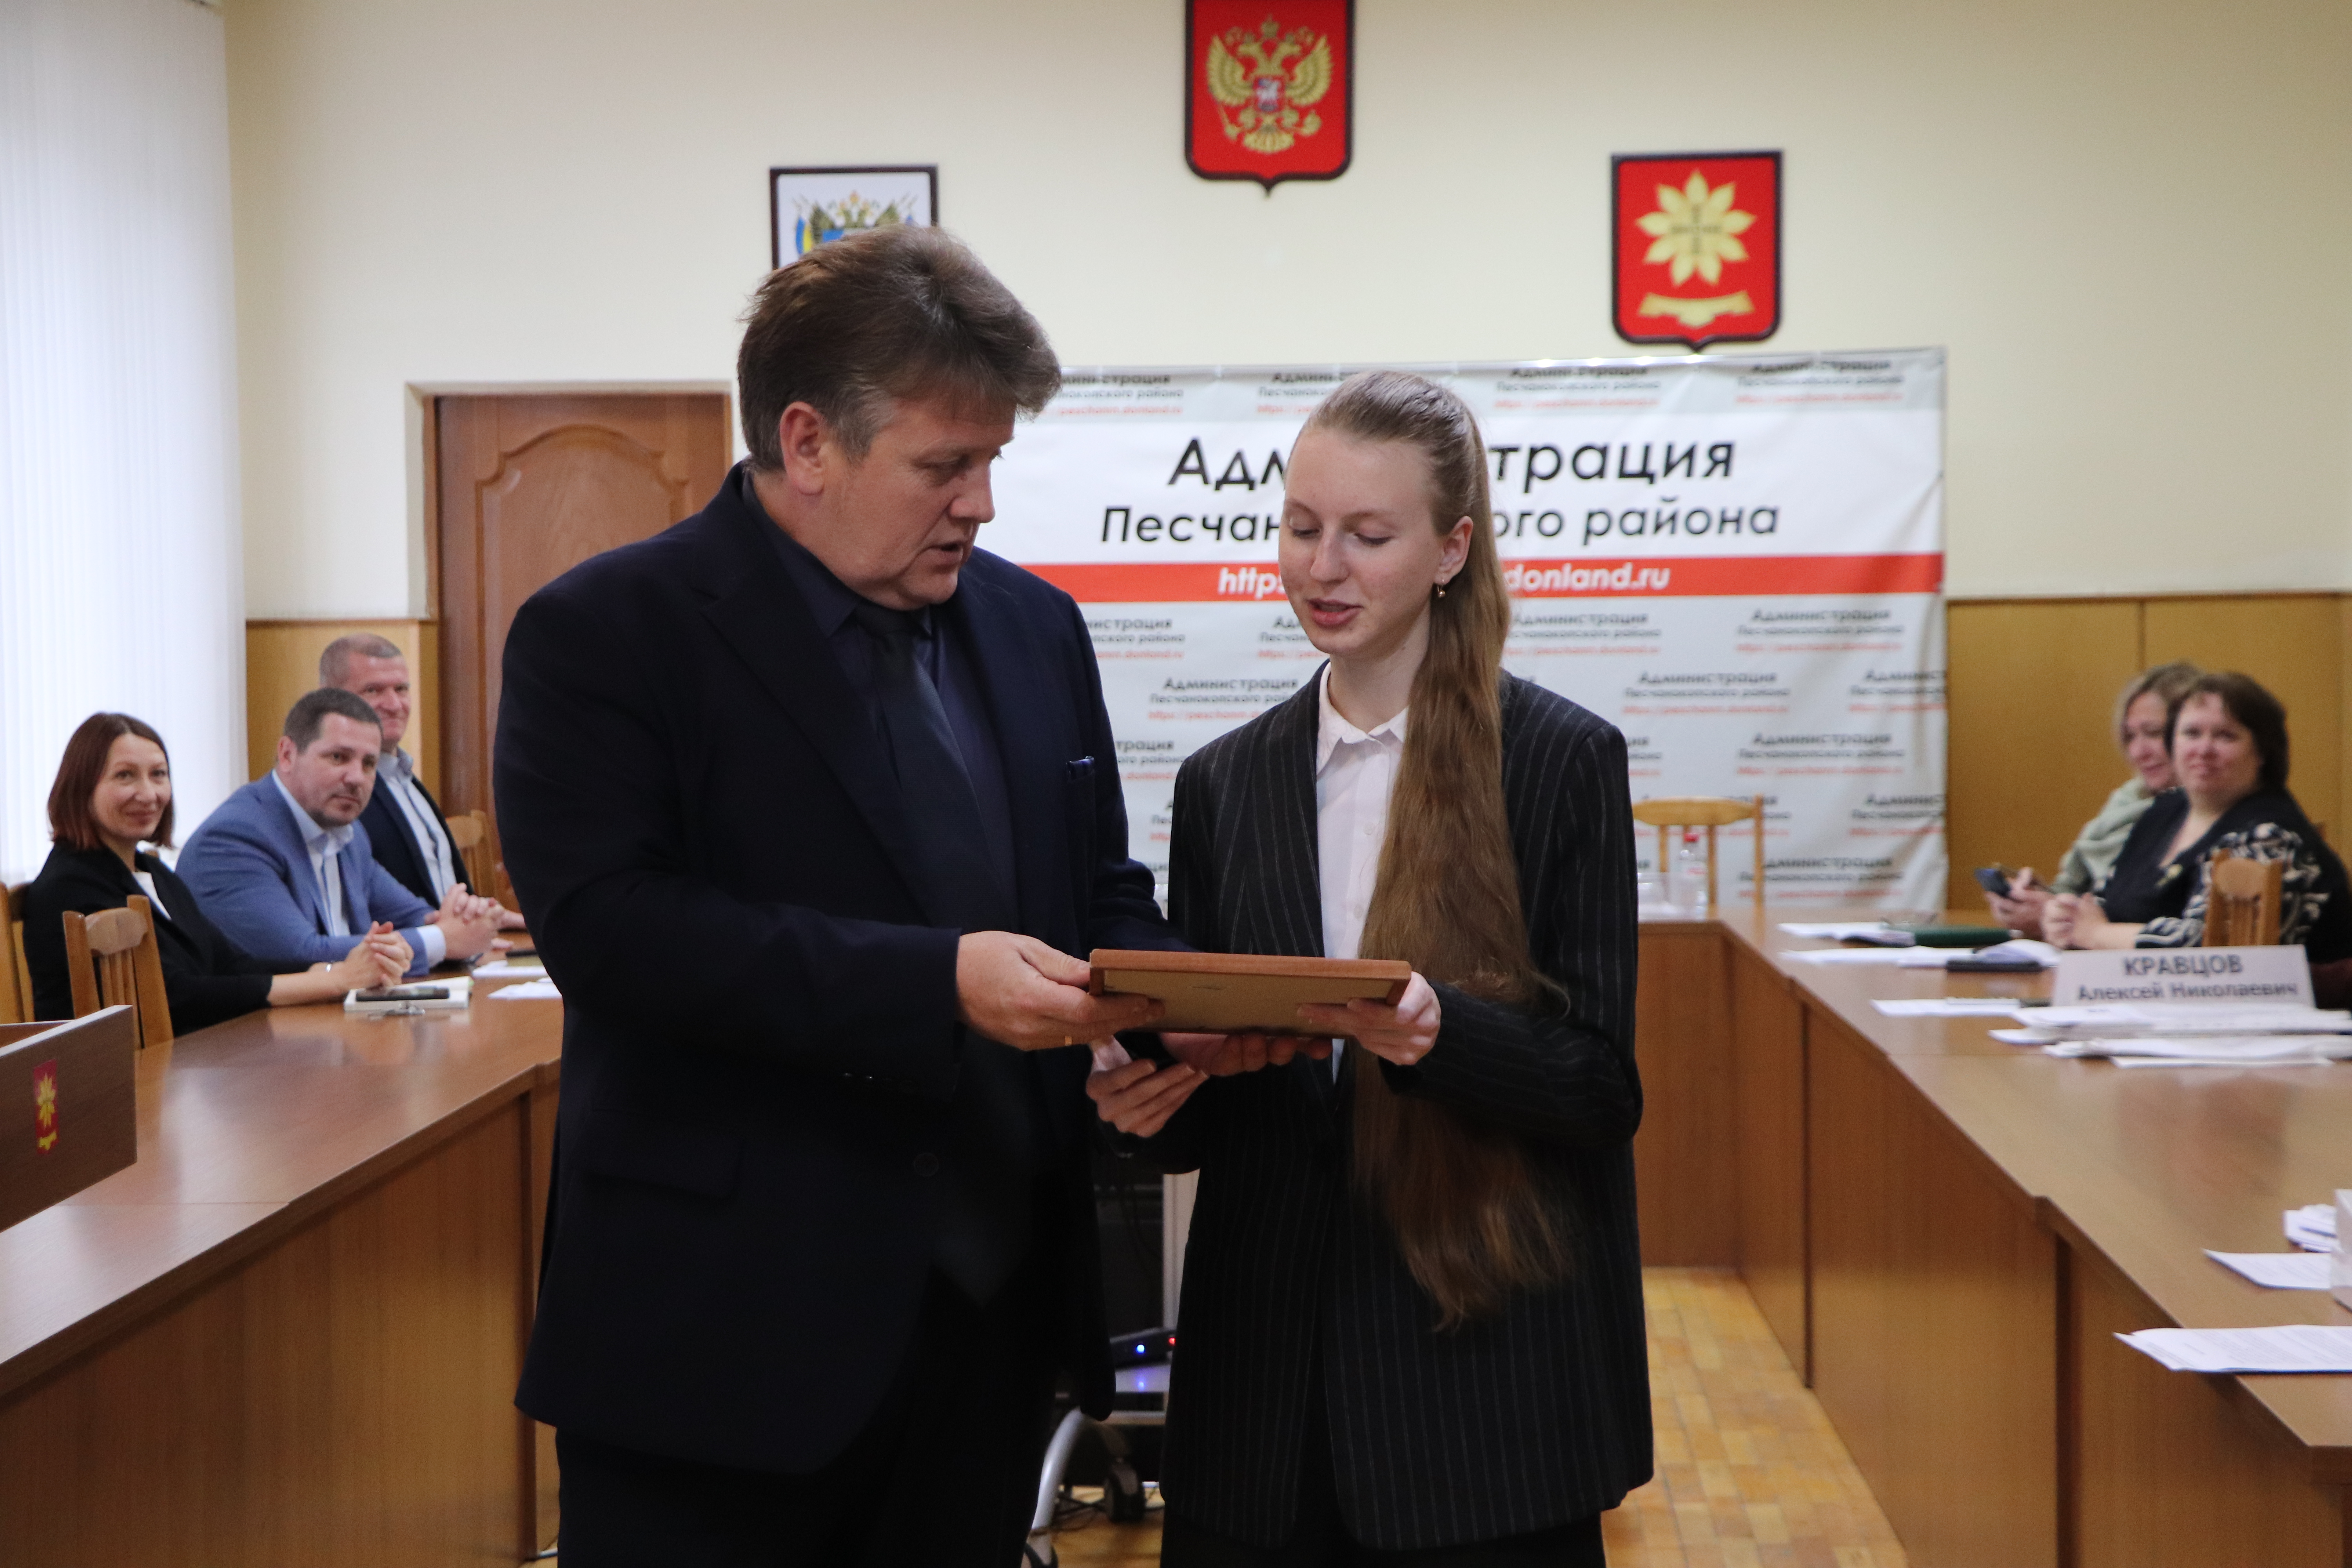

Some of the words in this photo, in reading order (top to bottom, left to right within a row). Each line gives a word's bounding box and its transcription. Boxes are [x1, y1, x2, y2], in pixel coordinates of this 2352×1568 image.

[1060, 374, 1171, 386] министрация
[1167, 436, 1736, 493] Адтрация
[1102, 506, 1564, 542] Песчаного
[1583, 497, 1779, 546] района
[1218, 561, 1671, 599] httpdonland.ru
[1086, 619, 1172, 630] истрация
[1163, 677, 1298, 691] Администрация
[1764, 857, 1893, 870] дминистрация
[2124, 953, 2244, 977] КРАВЦОВ
[2078, 982, 2165, 1001] Алексей
[2171, 977, 2299, 998] Николаевич
